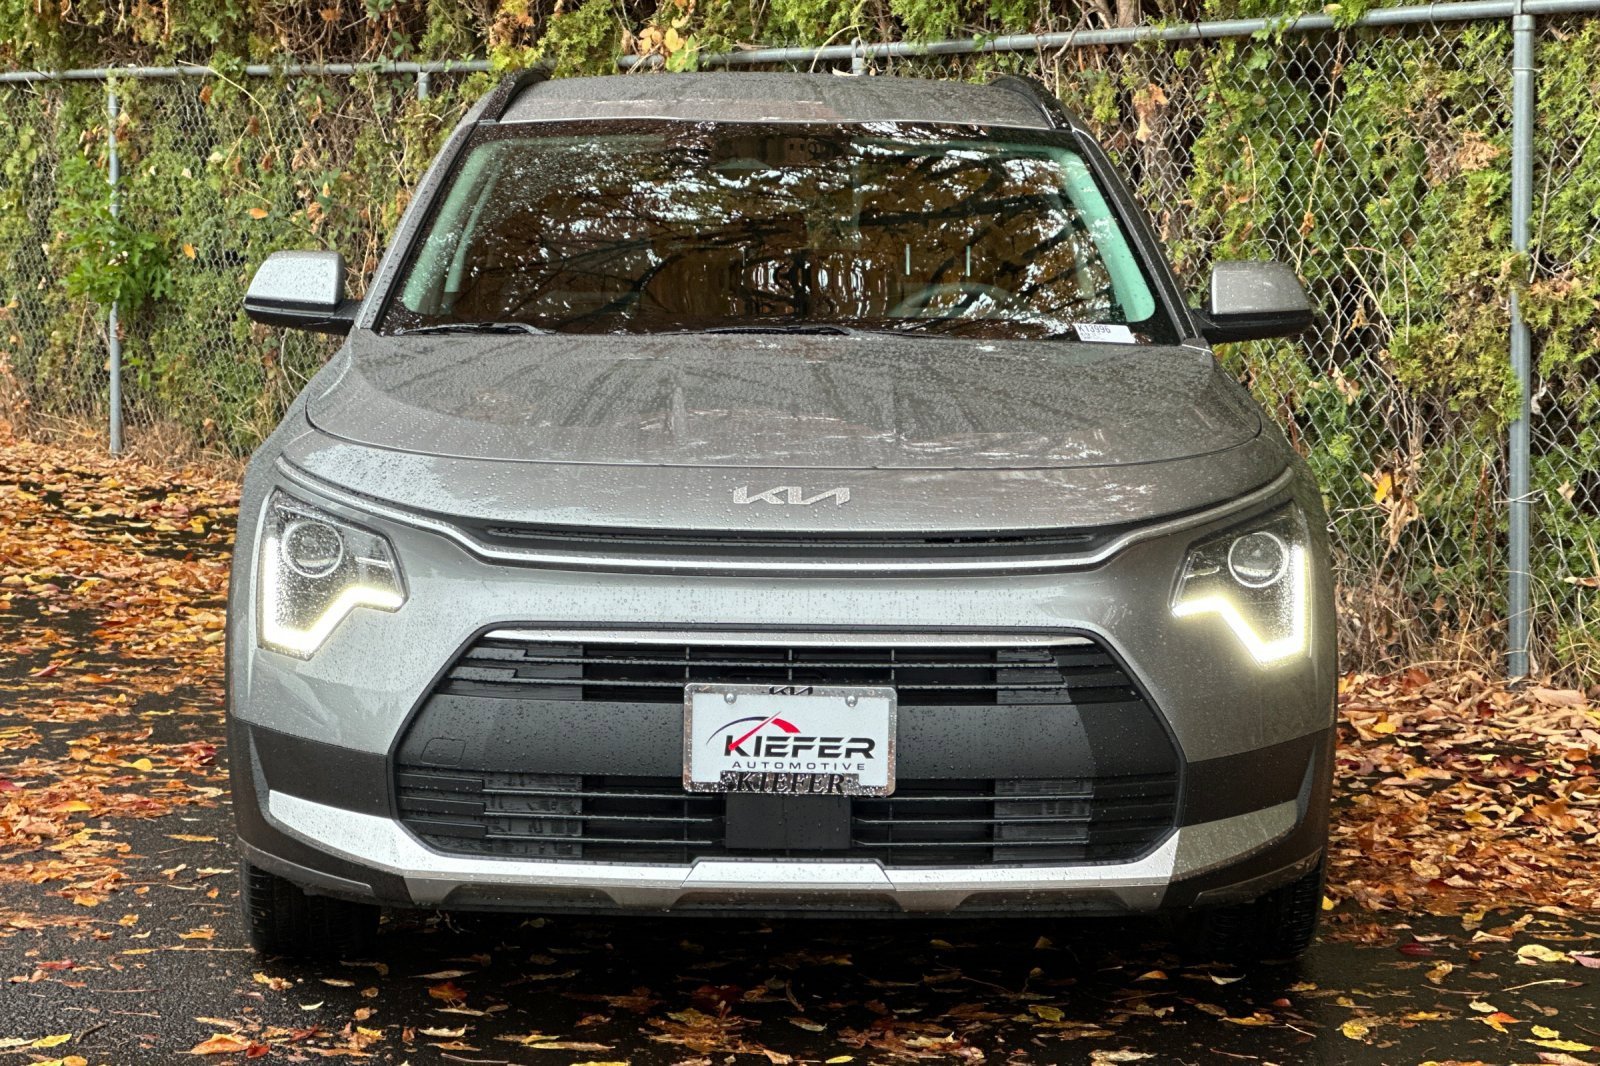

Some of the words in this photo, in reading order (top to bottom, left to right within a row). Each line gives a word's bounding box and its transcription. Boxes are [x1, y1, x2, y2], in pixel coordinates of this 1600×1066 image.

[733, 486, 850, 505] KIA
[723, 735, 876, 759] KIEFER
[732, 761, 865, 771] AUTOMOTIVE
[734, 771, 846, 794] KIEFER
